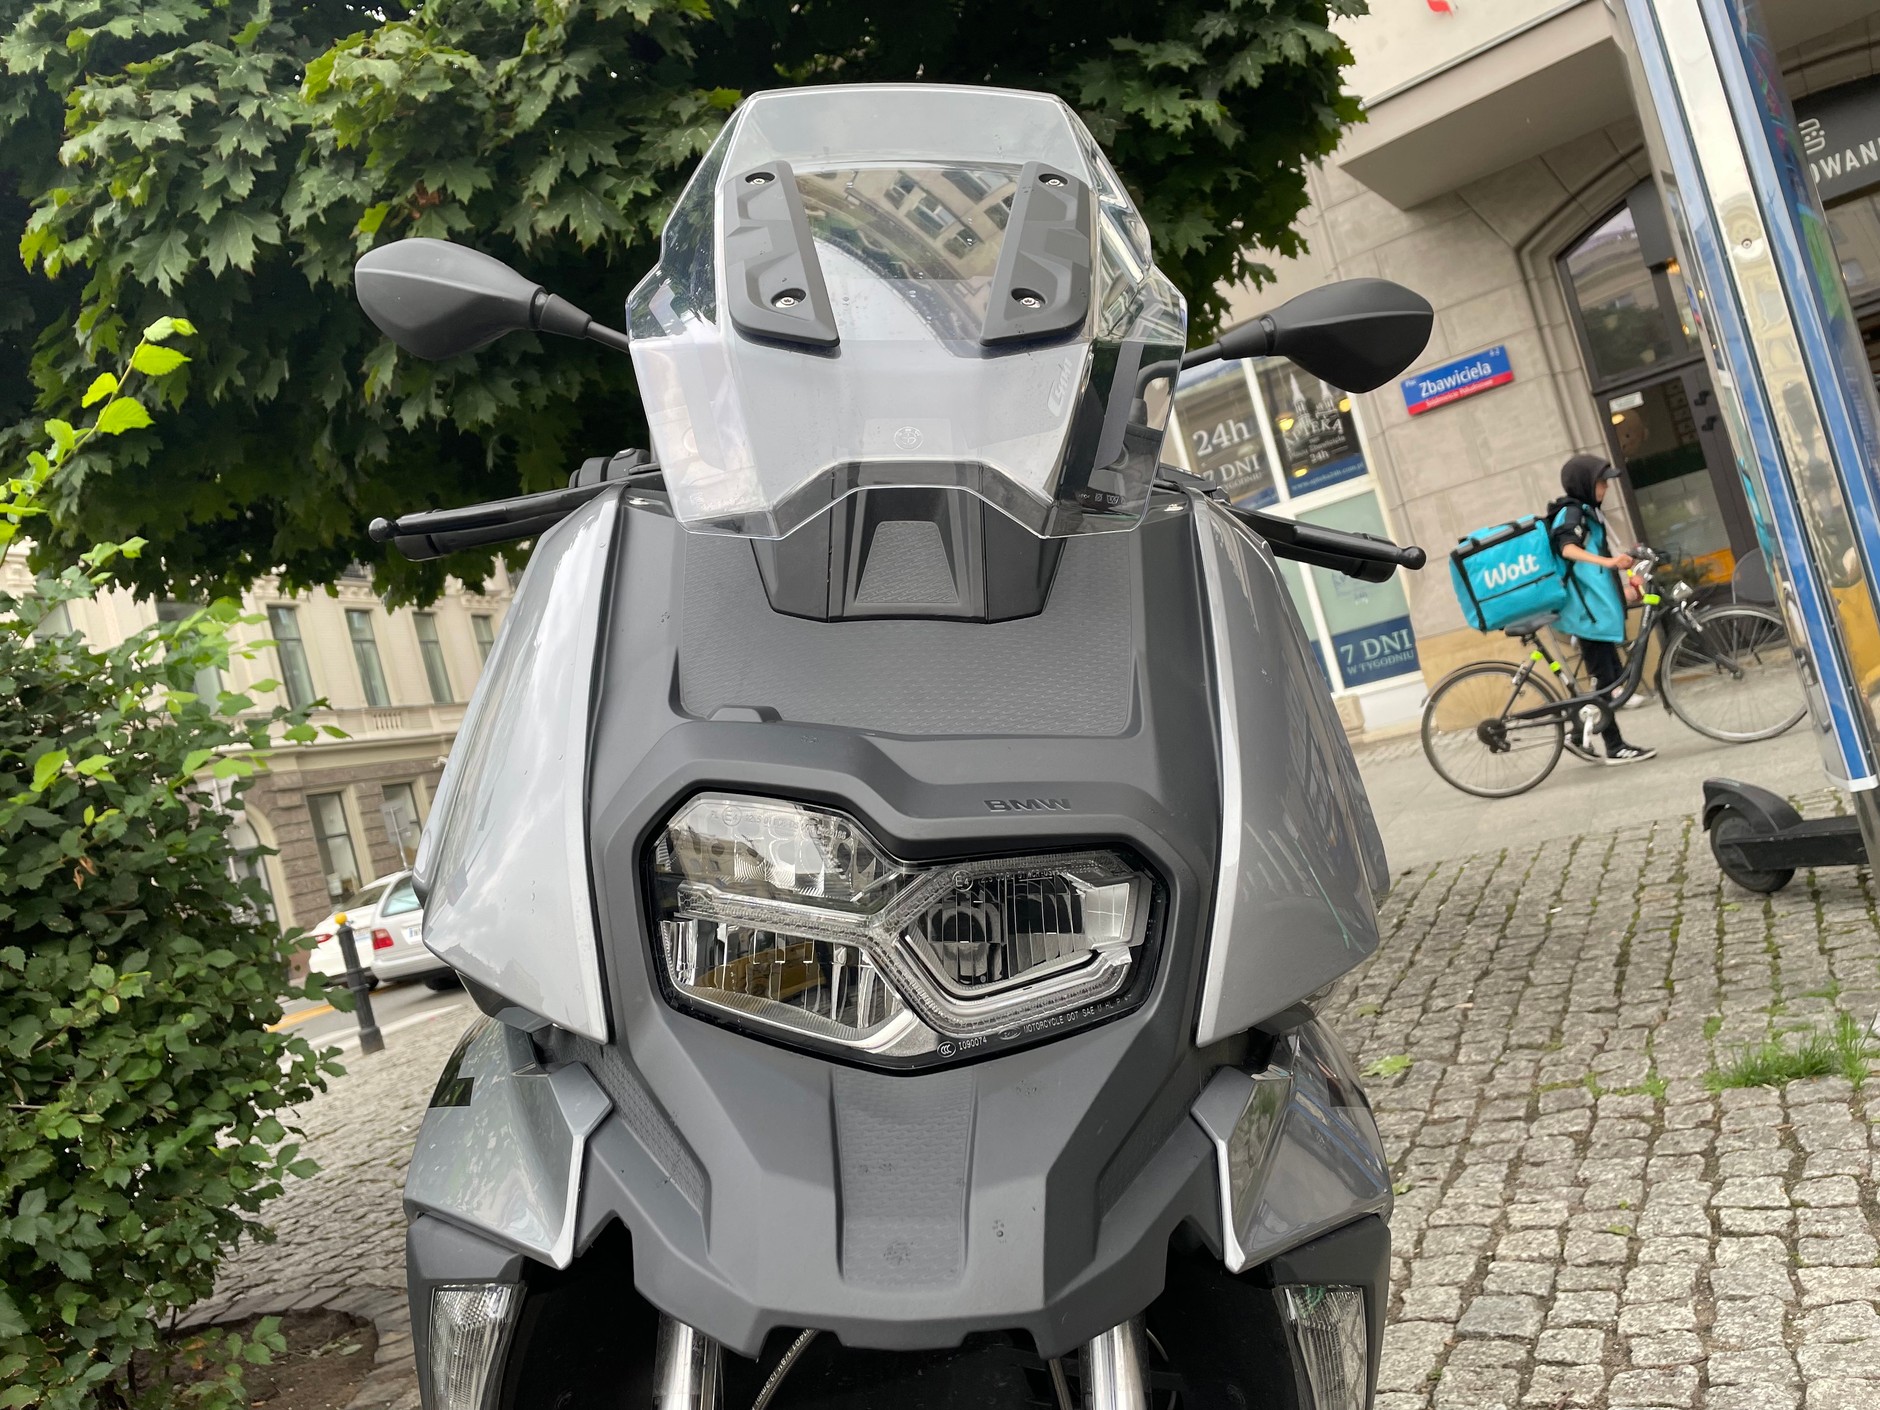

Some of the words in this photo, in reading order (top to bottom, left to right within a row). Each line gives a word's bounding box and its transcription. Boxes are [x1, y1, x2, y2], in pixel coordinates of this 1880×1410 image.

[1809, 136, 1880, 184] WAN
[1419, 361, 1492, 398] Zbawiciela
[1192, 419, 1250, 457] 24h
[1219, 453, 1260, 482] DNI
[1484, 554, 1540, 590] Wolt
[1340, 643, 1354, 666] 7
[1360, 628, 1412, 661] DNI
[1346, 664, 1358, 676] W
[1359, 650, 1415, 672] TYGODNIU
[983, 798, 1072, 812] BMW
[1023, 1017, 1064, 1034] MOTORCYCLE
[1067, 1011, 1079, 1022] DOT
[1082, 1006, 1095, 1018] SAE
